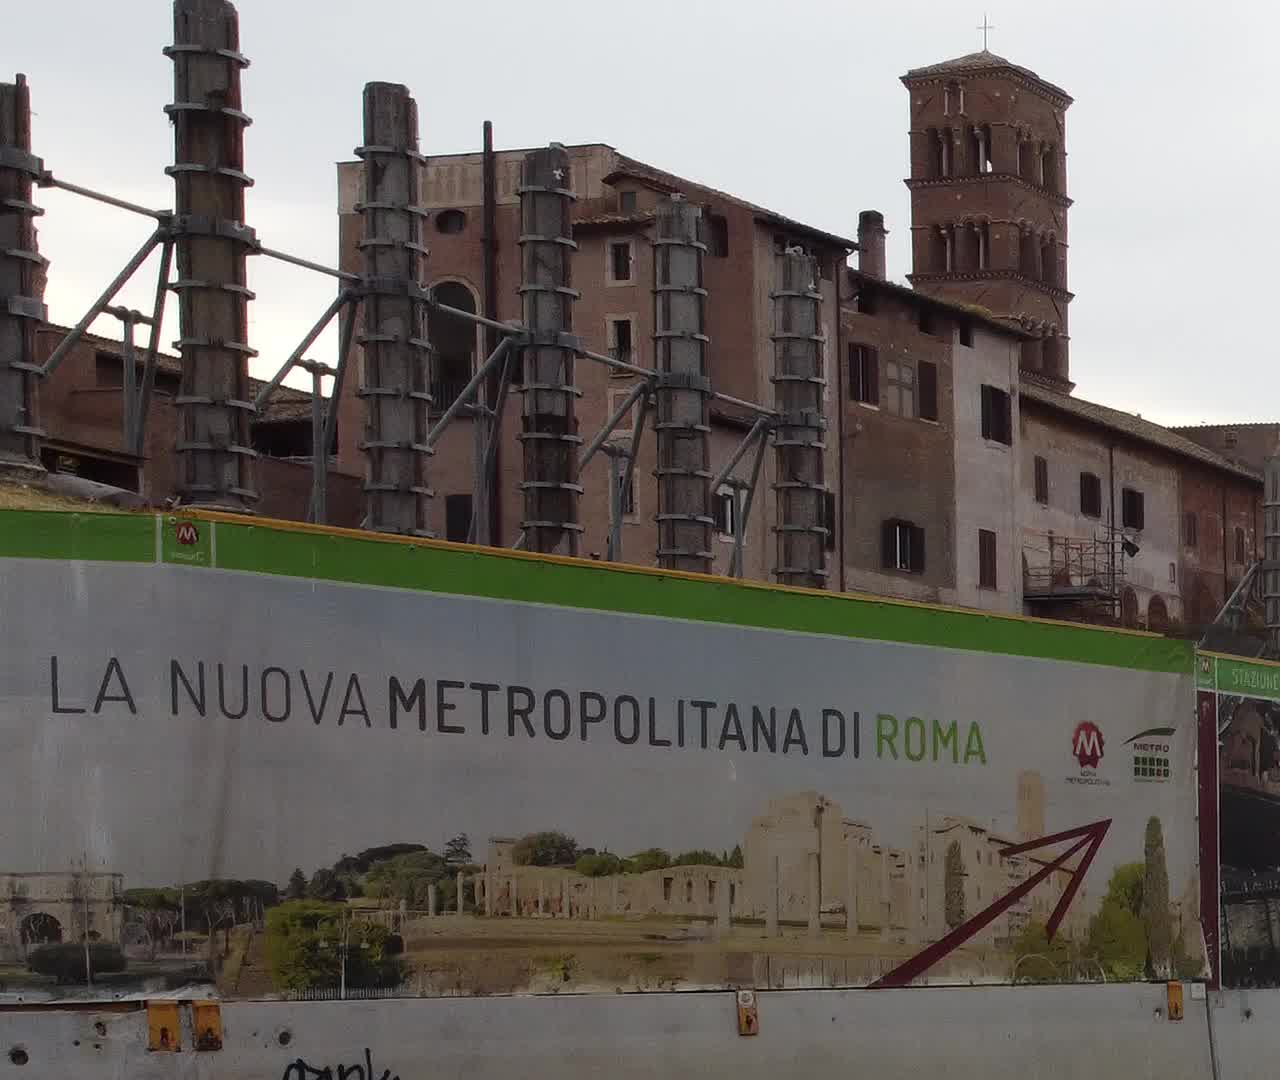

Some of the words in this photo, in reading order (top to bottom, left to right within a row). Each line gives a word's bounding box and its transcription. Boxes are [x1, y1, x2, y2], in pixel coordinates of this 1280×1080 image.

[50, 655, 138, 715] LA
[170, 658, 372, 729] NUOVA
[388, 675, 809, 756] METROPOLITANA
[821, 708, 861, 760] DI
[876, 713, 987, 766] ROMA
[1132, 742, 1170, 753] METRO
